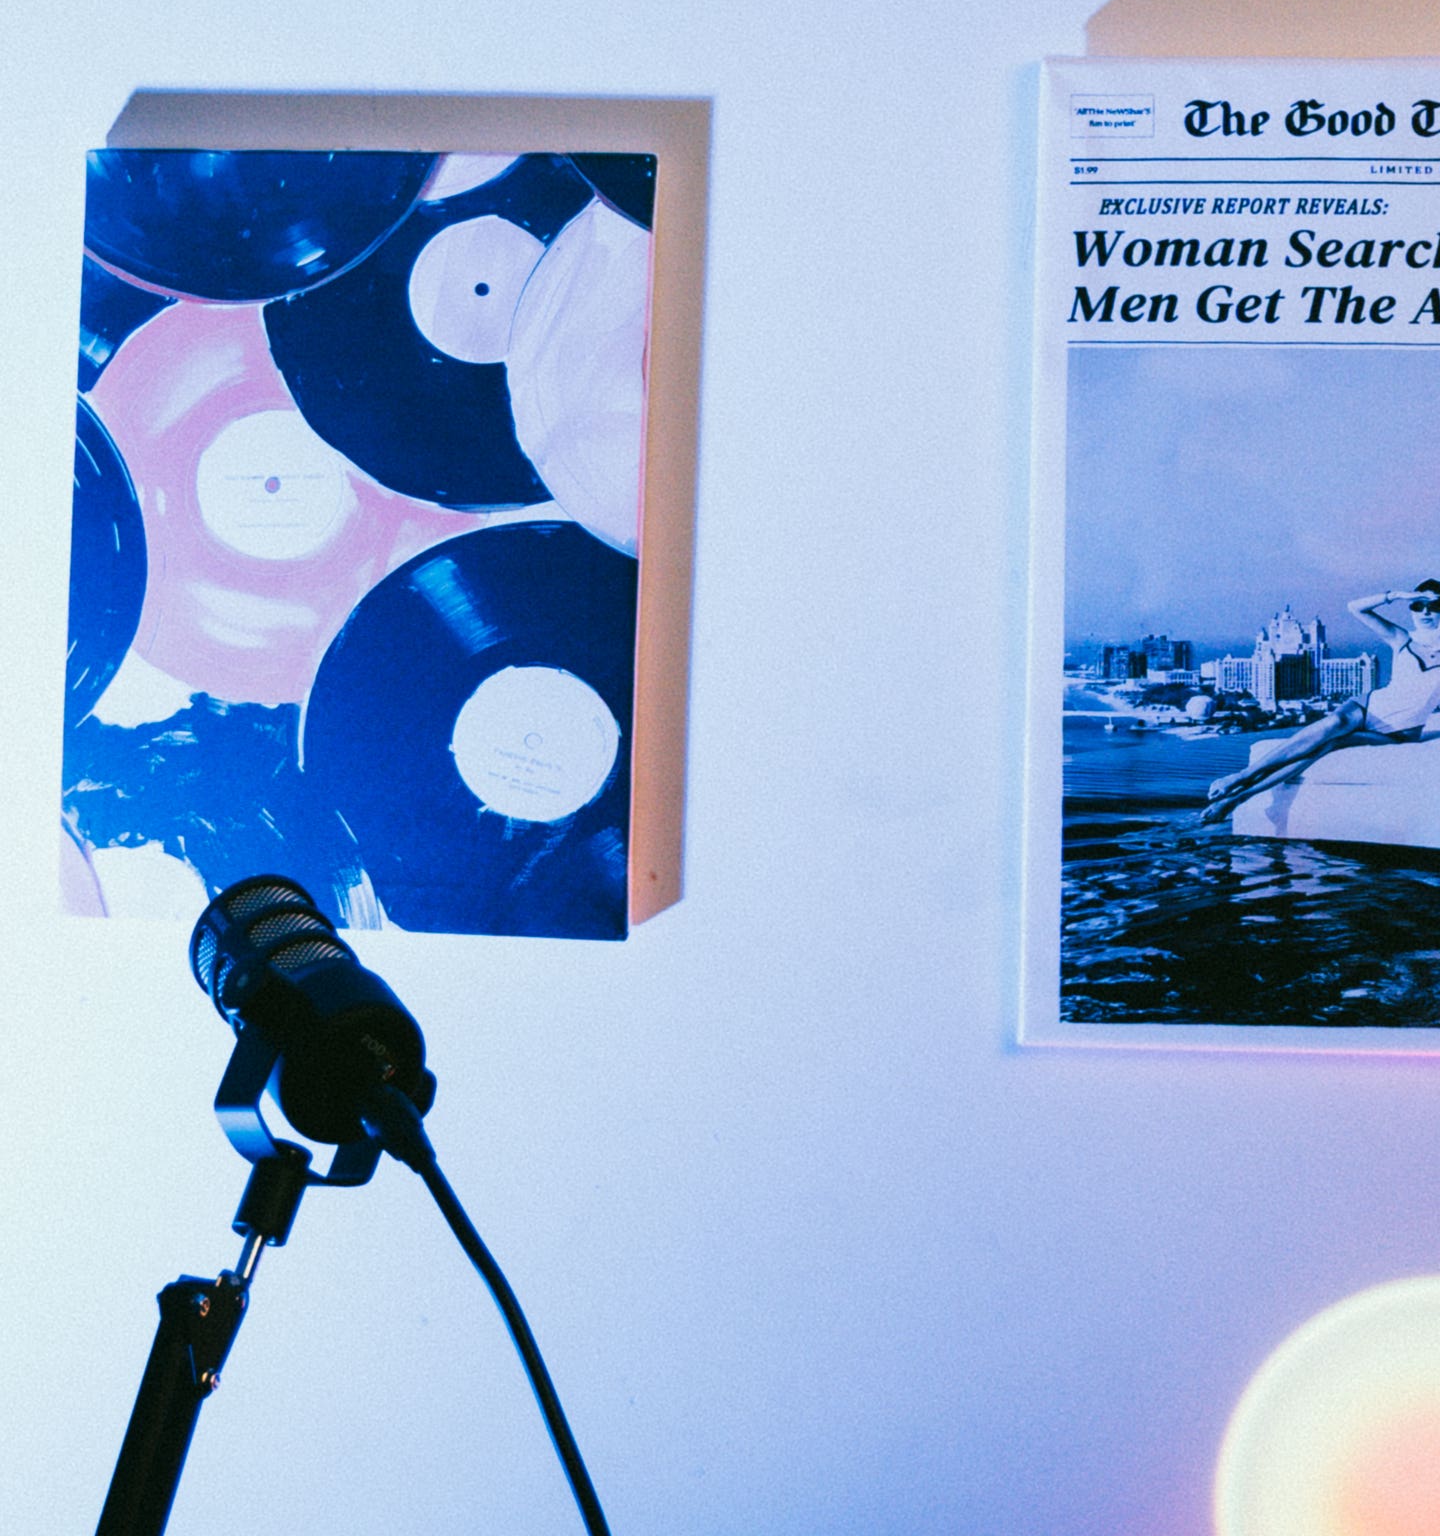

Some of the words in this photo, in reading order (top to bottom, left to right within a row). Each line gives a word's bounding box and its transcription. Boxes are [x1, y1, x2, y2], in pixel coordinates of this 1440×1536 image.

[1184, 99, 1271, 138] The
[1284, 98, 1396, 137] Good
[1370, 165, 1433, 175] LIMITED
[1098, 197, 1207, 216] EXCLUSIVE
[1210, 197, 1291, 215] REPORT
[1295, 197, 1389, 216] REVEALS:
[1073, 230, 1269, 268] Woman
[1066, 285, 1179, 323] Men
[1196, 284, 1286, 324] Get
[1301, 285, 1397, 325] The
